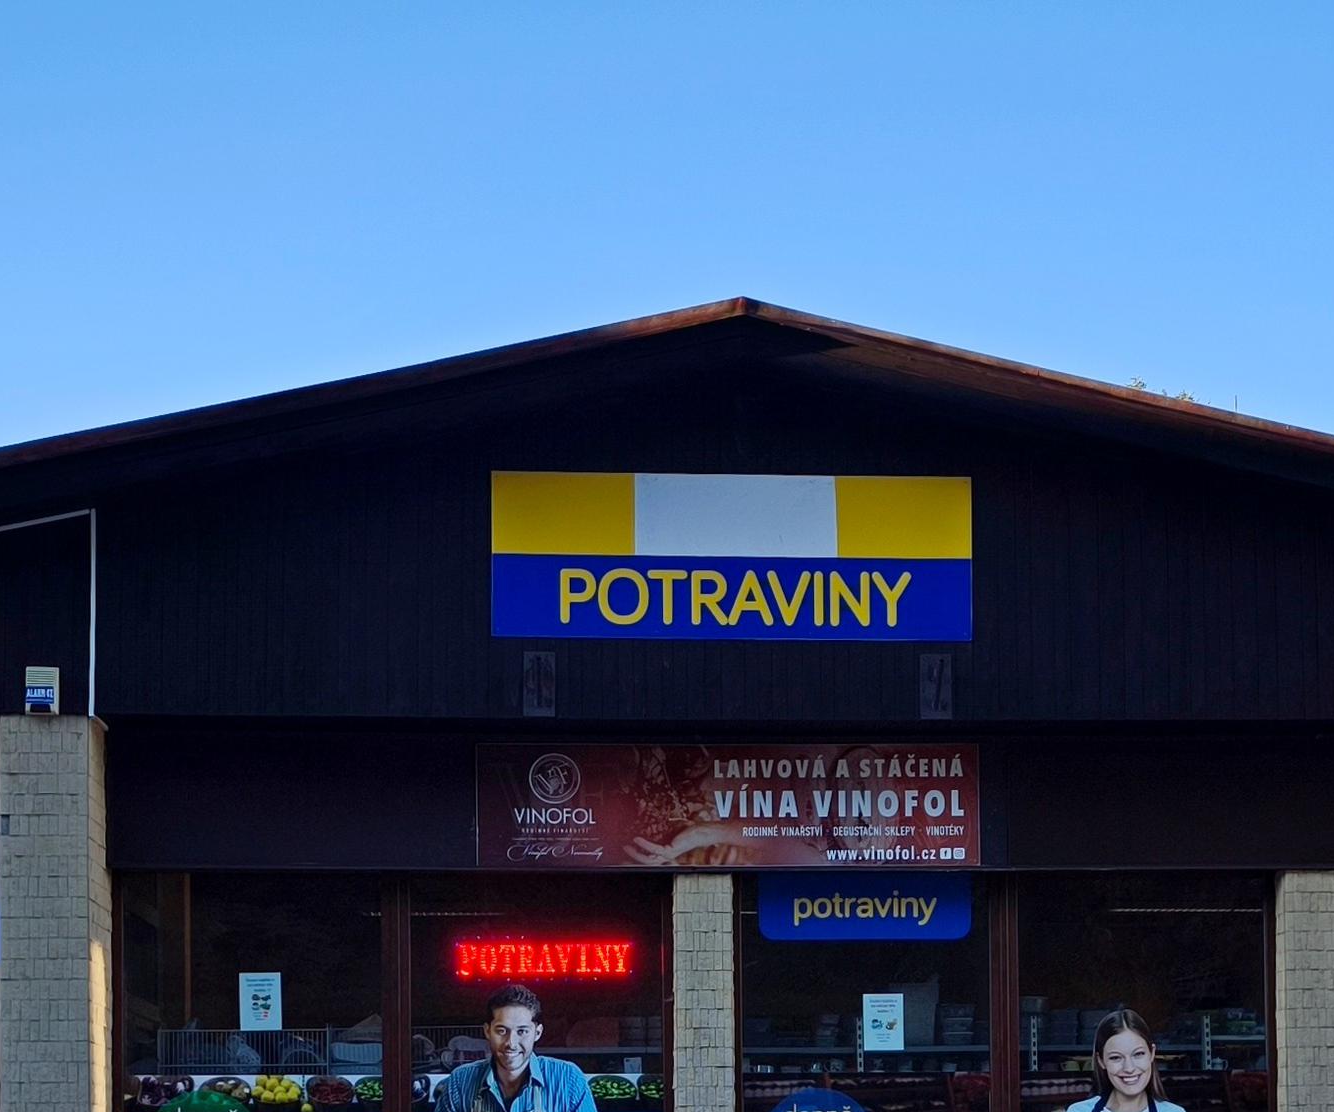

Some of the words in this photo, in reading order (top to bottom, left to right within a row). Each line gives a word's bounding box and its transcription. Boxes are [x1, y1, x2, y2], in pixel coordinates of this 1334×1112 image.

[559, 568, 911, 627] POTRAVINY
[714, 754, 827, 779] LAHVOVÁ
[835, 759, 850, 779] A
[859, 754, 964, 779] STÁČENÁ
[714, 783, 799, 818] VÍNA
[813, 789, 965, 818] VINOFOL
[514, 807, 596, 825] VINOFOL
[742, 825, 778, 838] RODINNÉ
[781, 825, 823, 838] VINAŘSTVÍ
[833, 825, 882, 838] DEGUSTAČNÍ
[885, 827, 916, 838] SKLEPY
[926, 824, 965, 837] VINOTÉKY
[827, 845, 937, 861] www.vinofol.cz
[792, 888, 938, 927] potraviny
[459, 943, 630, 976] POTRAVINY
